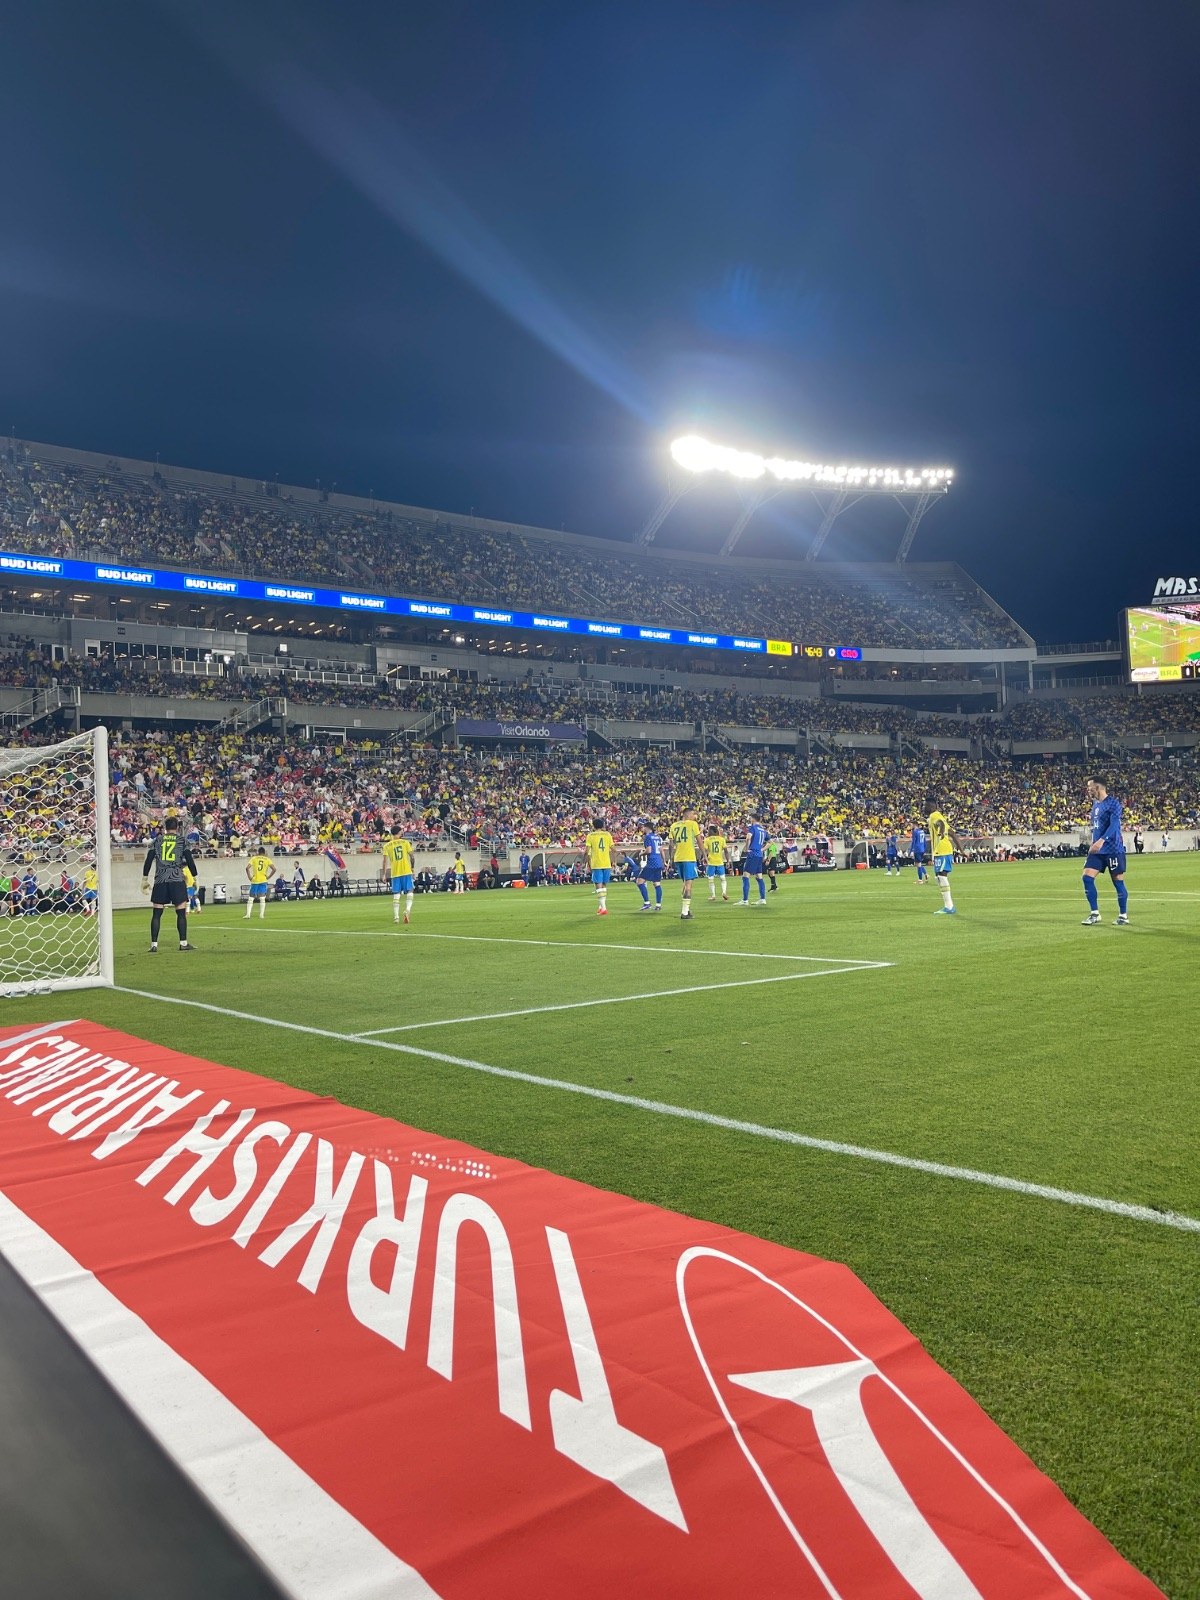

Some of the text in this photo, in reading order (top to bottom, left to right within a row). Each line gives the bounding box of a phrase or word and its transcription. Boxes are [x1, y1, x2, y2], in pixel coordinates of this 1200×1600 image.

[0, 557, 61, 573] BUD LIGHT
[97, 568, 153, 583] BUD LIGHT
[185, 579, 236, 592] BUD LIGHT
[1153, 576, 1200, 596] MAS
[266, 588, 313, 600] BUD LIGHT
[341, 596, 385, 608] BUD LIGHT
[410, 604, 451, 615] BUD LIGHT
[474, 611, 512, 622] BUD LIGHT
[533, 618, 568, 628] BUD LIGHT
[588, 624, 621, 634] BUD LIGHT
[770, 643, 787, 652] BRA
[828, 648, 835, 657] 0
[1160, 669, 1178, 677] BRA
[673, 826, 687, 843] 24
[758, 830, 765, 845] 11
[598, 837, 605, 851] 4
[711, 841, 720, 853] 18
[161, 841, 176, 861] 12
[393, 845, 403, 860] 15
[257, 860, 264, 871] 5
[1109, 857, 1118, 867] 14
[135, 1099, 689, 1534] TURKISH
